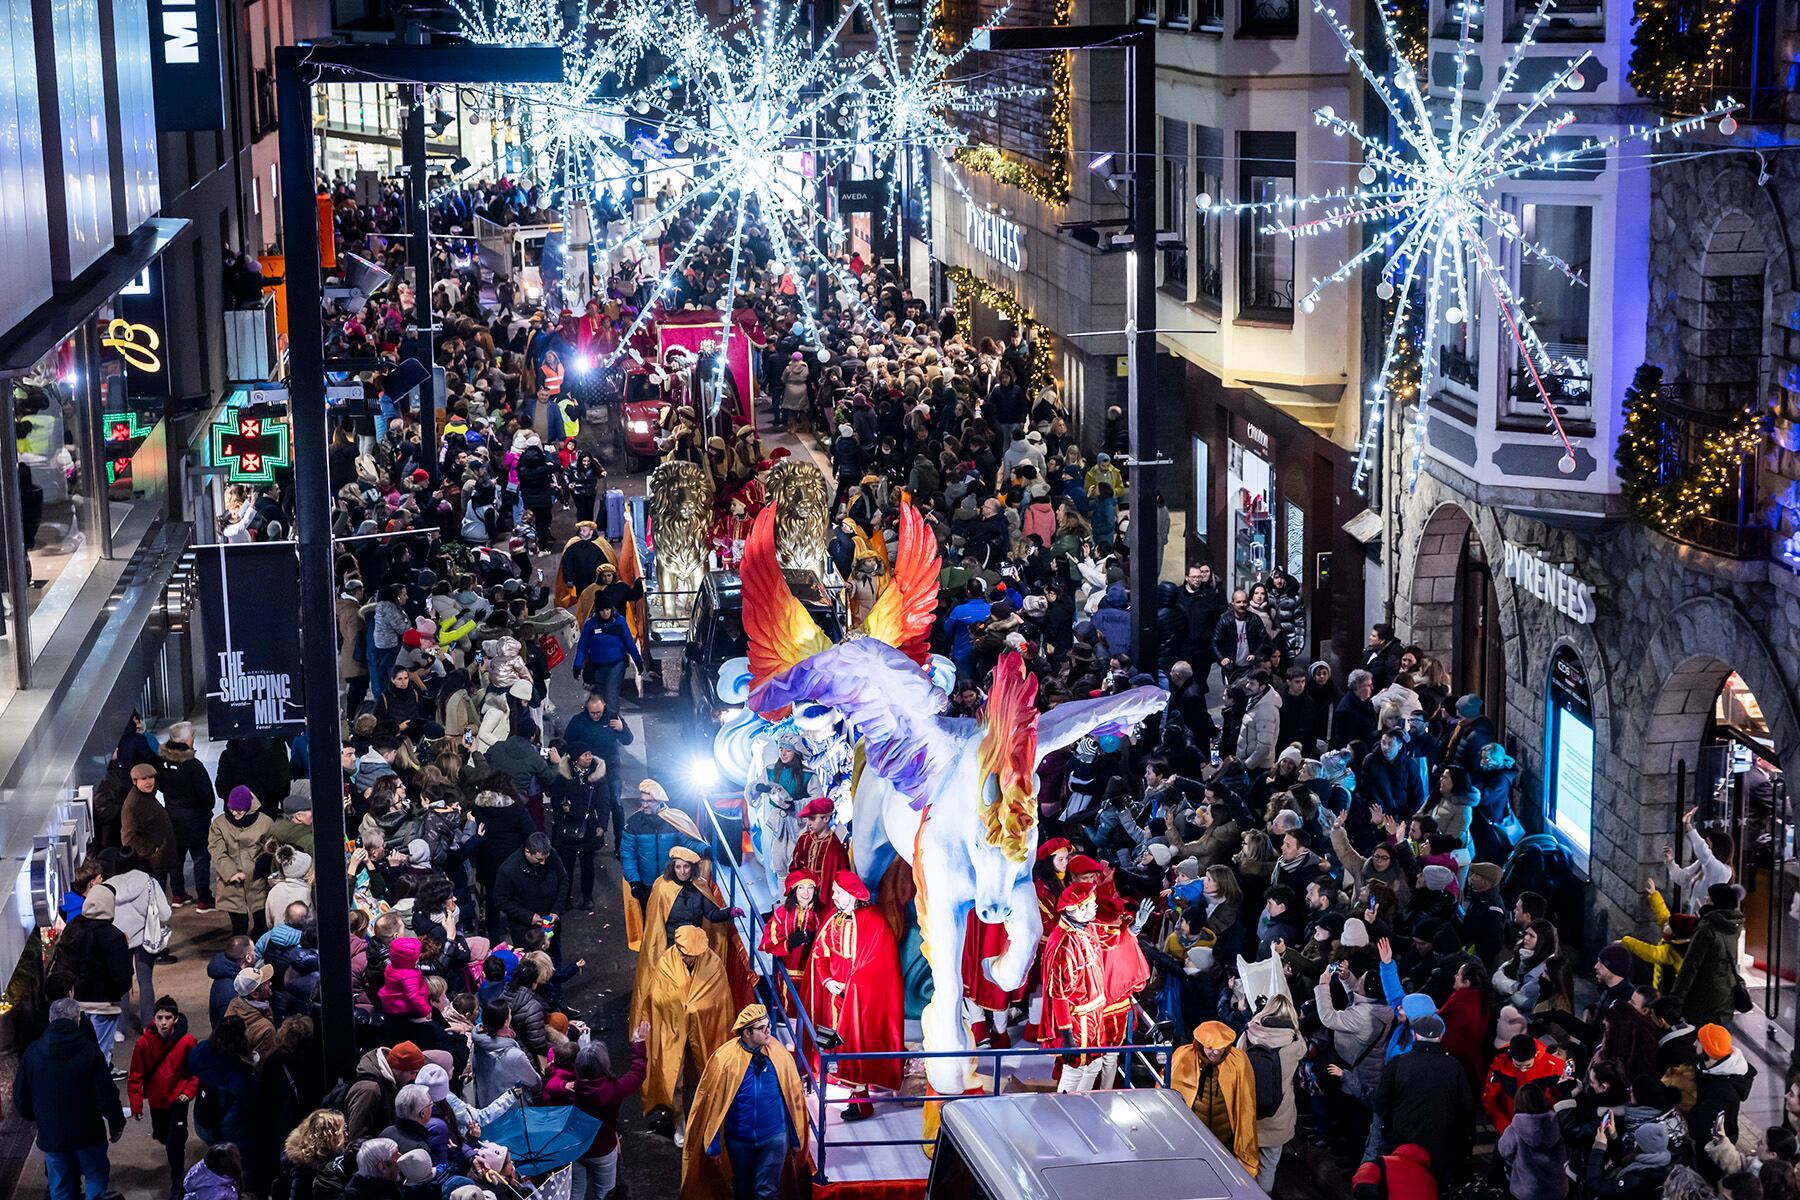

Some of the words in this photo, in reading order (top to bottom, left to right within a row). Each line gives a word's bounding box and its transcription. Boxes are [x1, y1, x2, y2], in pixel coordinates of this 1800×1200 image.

[218, 651, 245, 677] THE
[219, 674, 291, 702] SHOPPING
[254, 698, 287, 724] MILE
